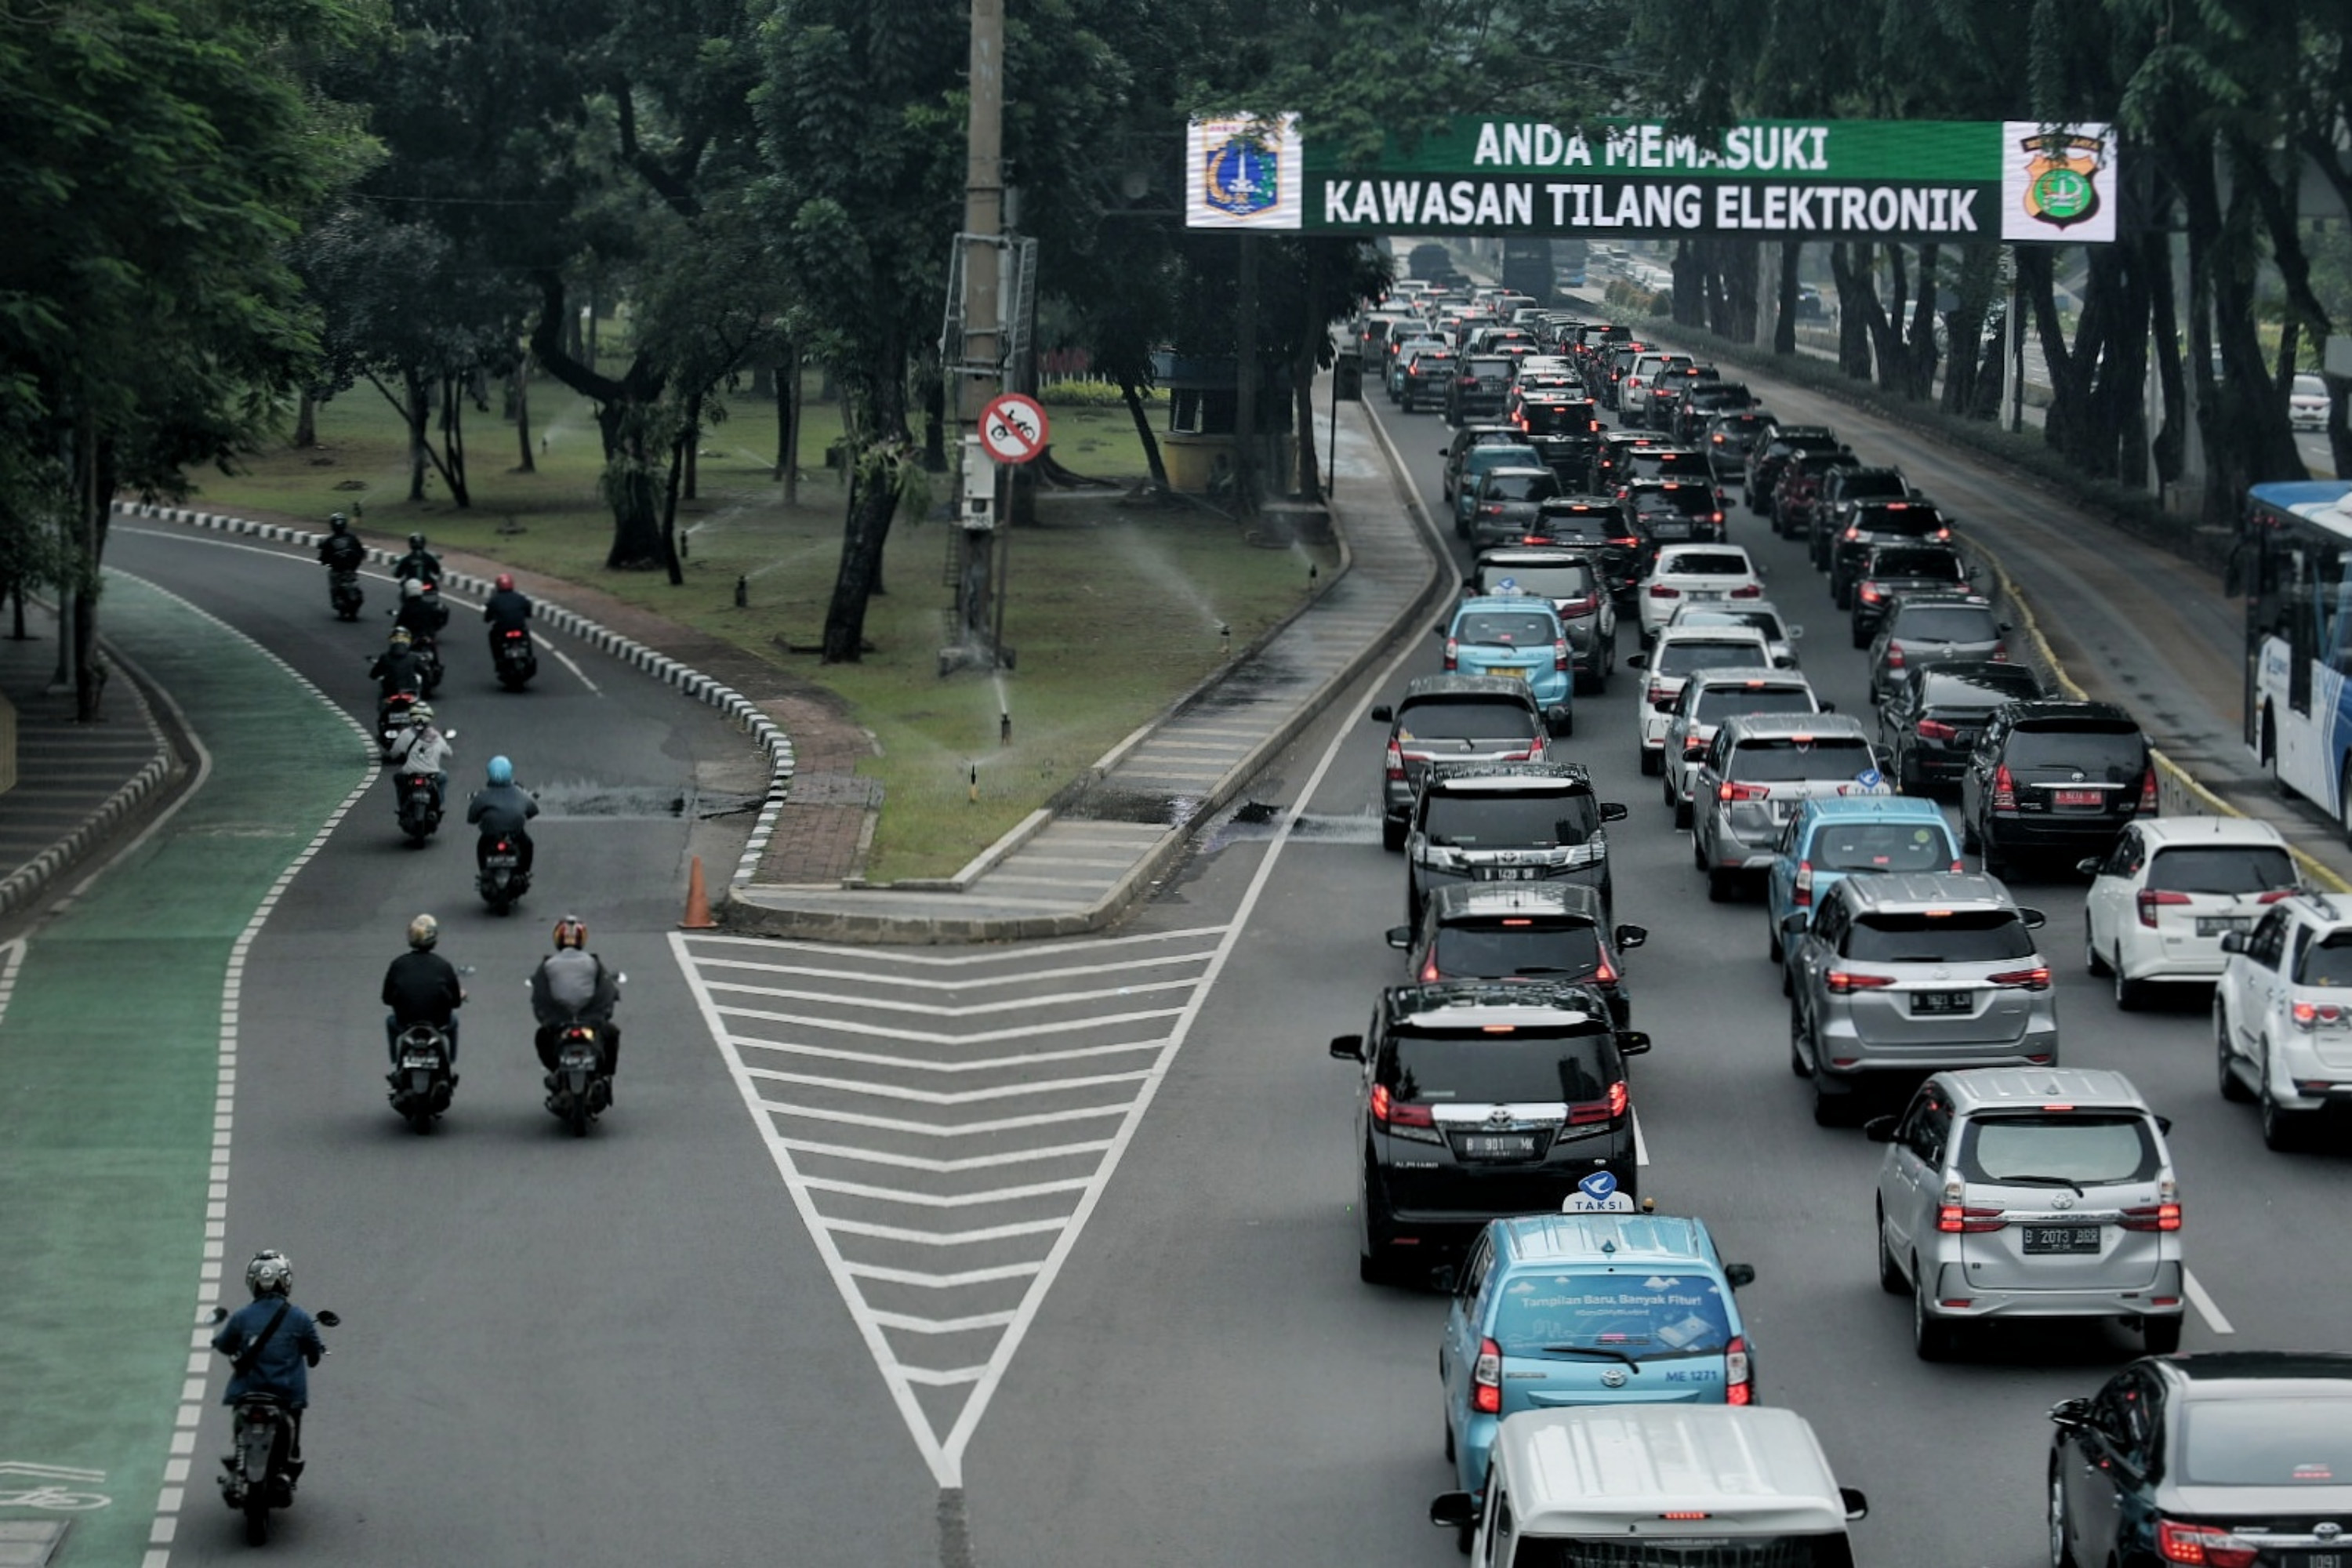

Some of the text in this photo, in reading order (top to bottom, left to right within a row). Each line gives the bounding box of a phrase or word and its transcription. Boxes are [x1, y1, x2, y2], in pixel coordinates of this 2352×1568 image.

[1473, 122, 1592, 166] ANDA
[1325, 180, 1979, 232] KAWASAN TILANG ELEKTRONIK
[1486, 1138, 1504, 1150] 901
[1575, 1201, 1622, 1210] TAKSI
[2040, 1230, 2070, 1243] 2073
[1522, 1295, 1581, 1308] Tampilan
[1619, 1294, 1665, 1306] Banyak
[1665, 1370, 1718, 1381] ME 1271
